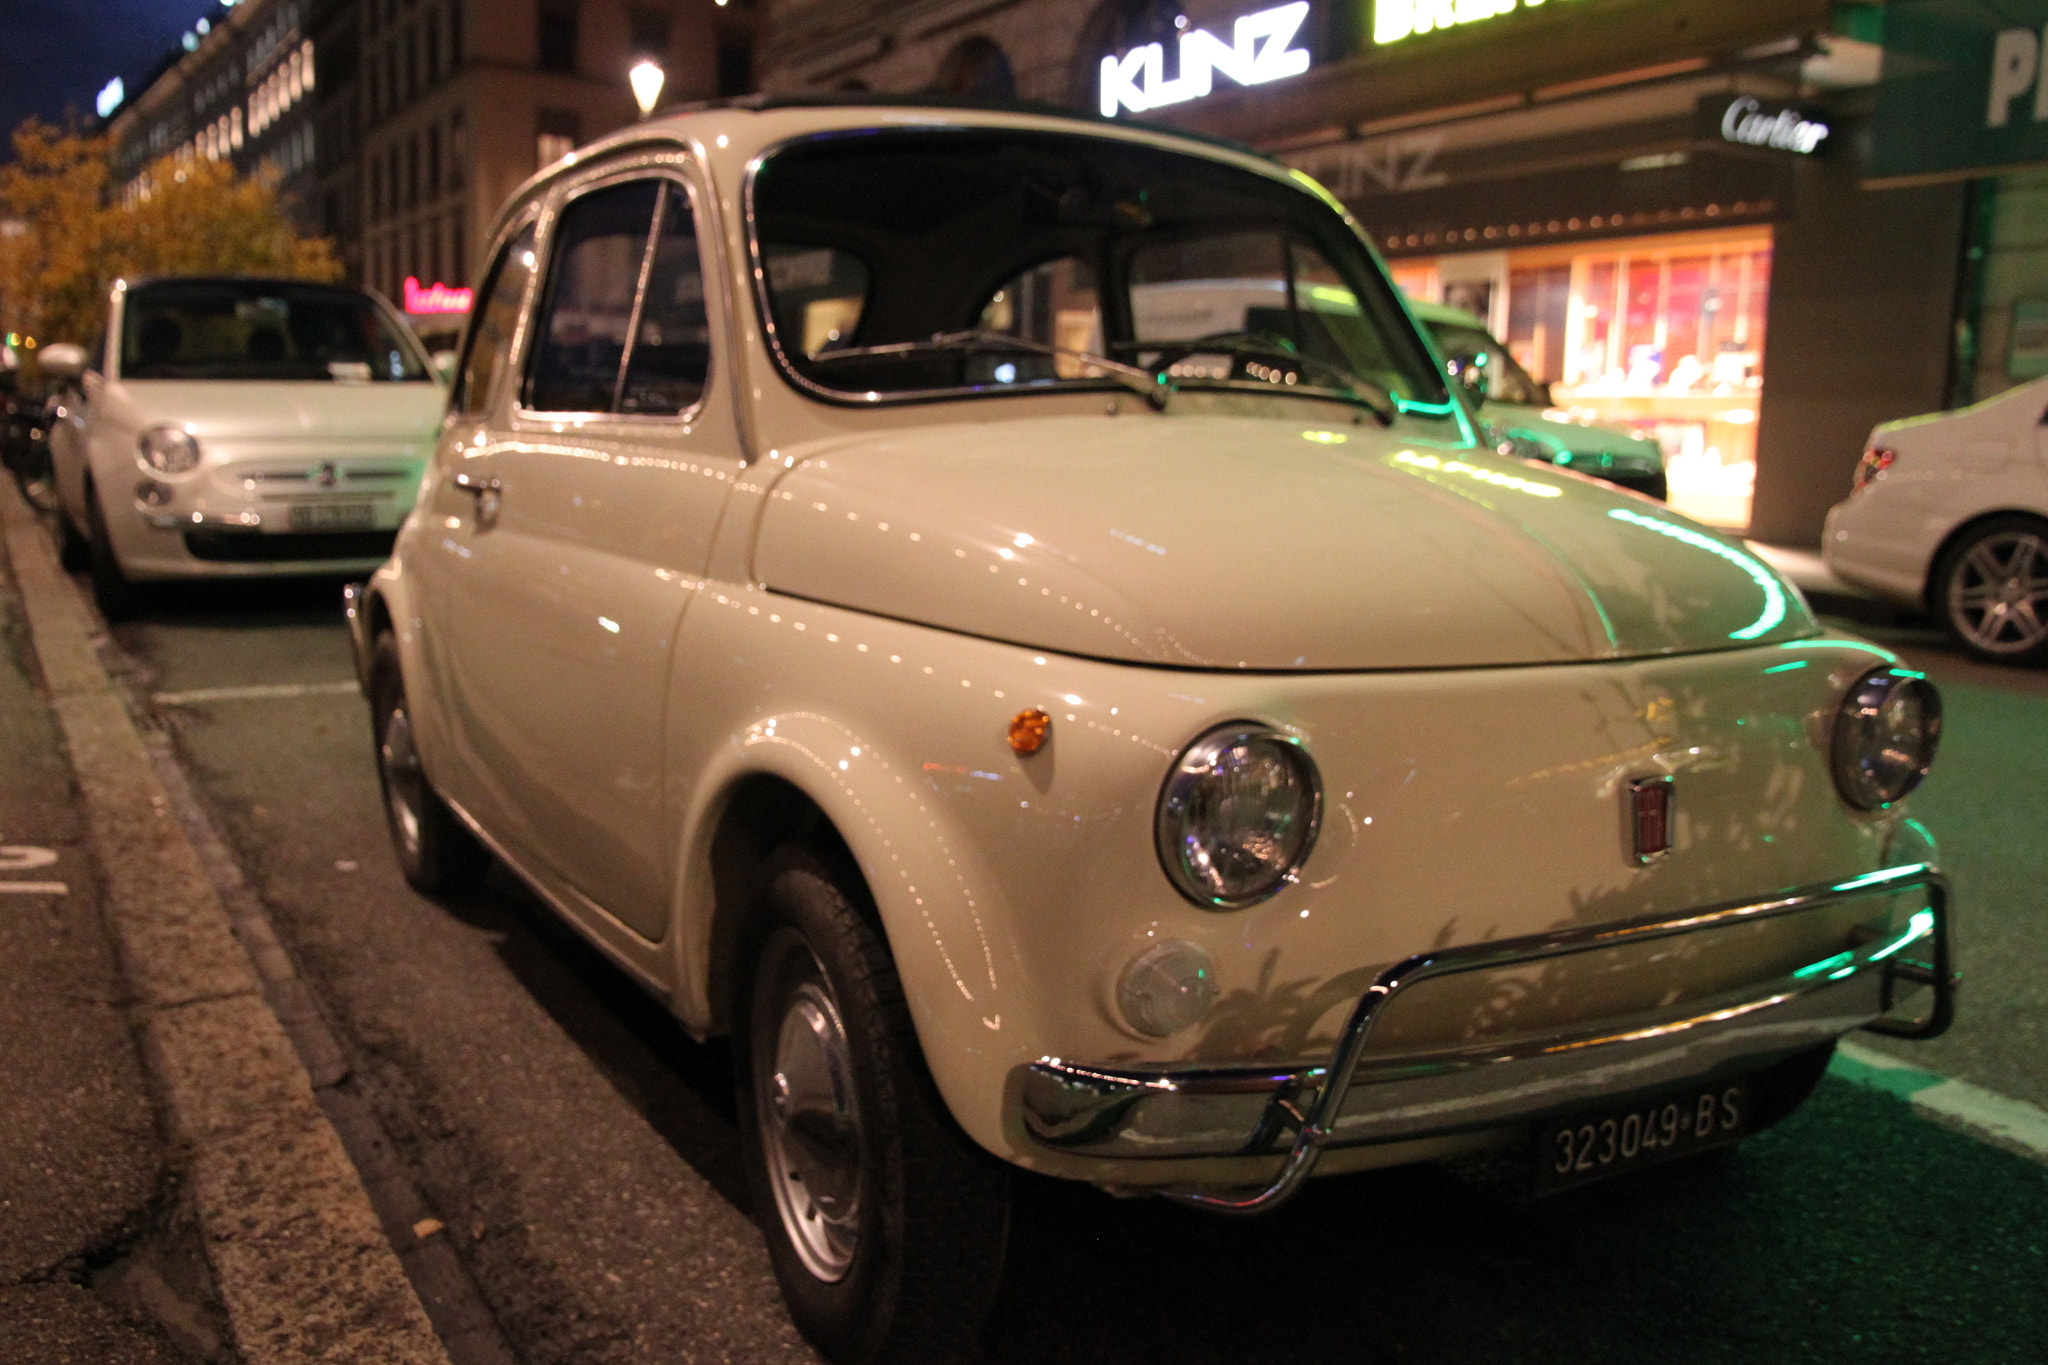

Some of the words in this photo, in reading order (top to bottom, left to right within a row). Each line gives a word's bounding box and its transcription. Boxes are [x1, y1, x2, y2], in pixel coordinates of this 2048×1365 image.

[1100, 1, 1310, 117] KUNZ
[1721, 95, 1829, 154] Cartier
[1302, 131, 1448, 200] UNZ
